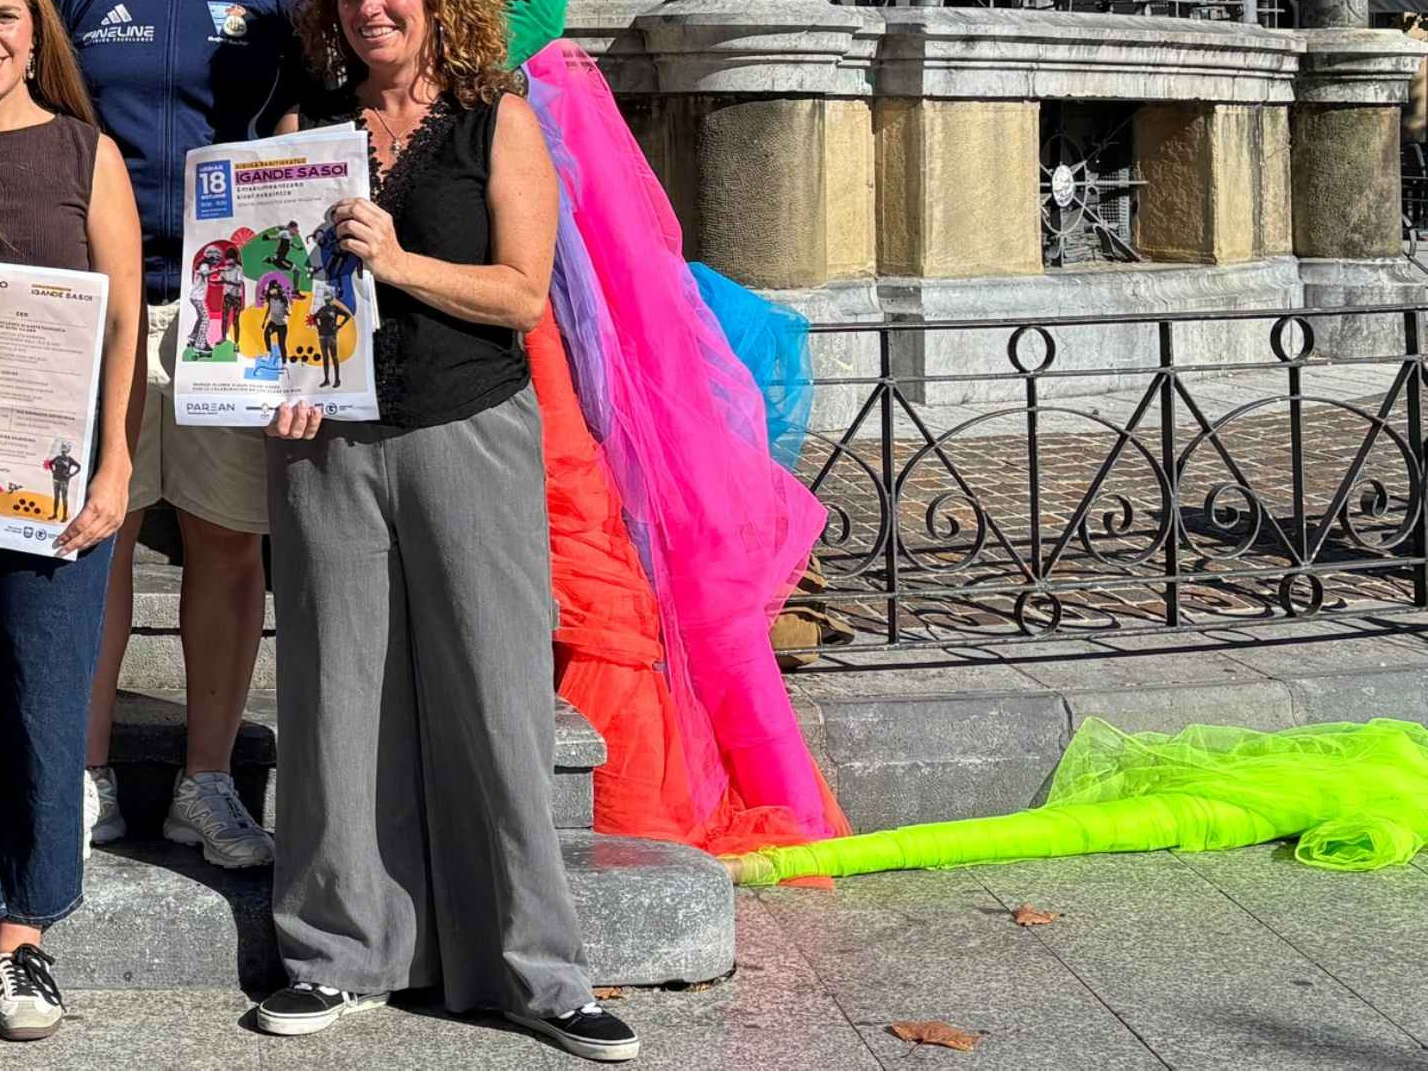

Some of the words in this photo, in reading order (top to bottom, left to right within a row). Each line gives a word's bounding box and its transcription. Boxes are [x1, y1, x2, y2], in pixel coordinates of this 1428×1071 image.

[235, 168, 293, 185] IGANDE
[297, 162, 348, 178] SASOI
[199, 171, 226, 195] 18
[31, 289, 64, 299] IGANDE
[186, 402, 236, 412] PAREAN
